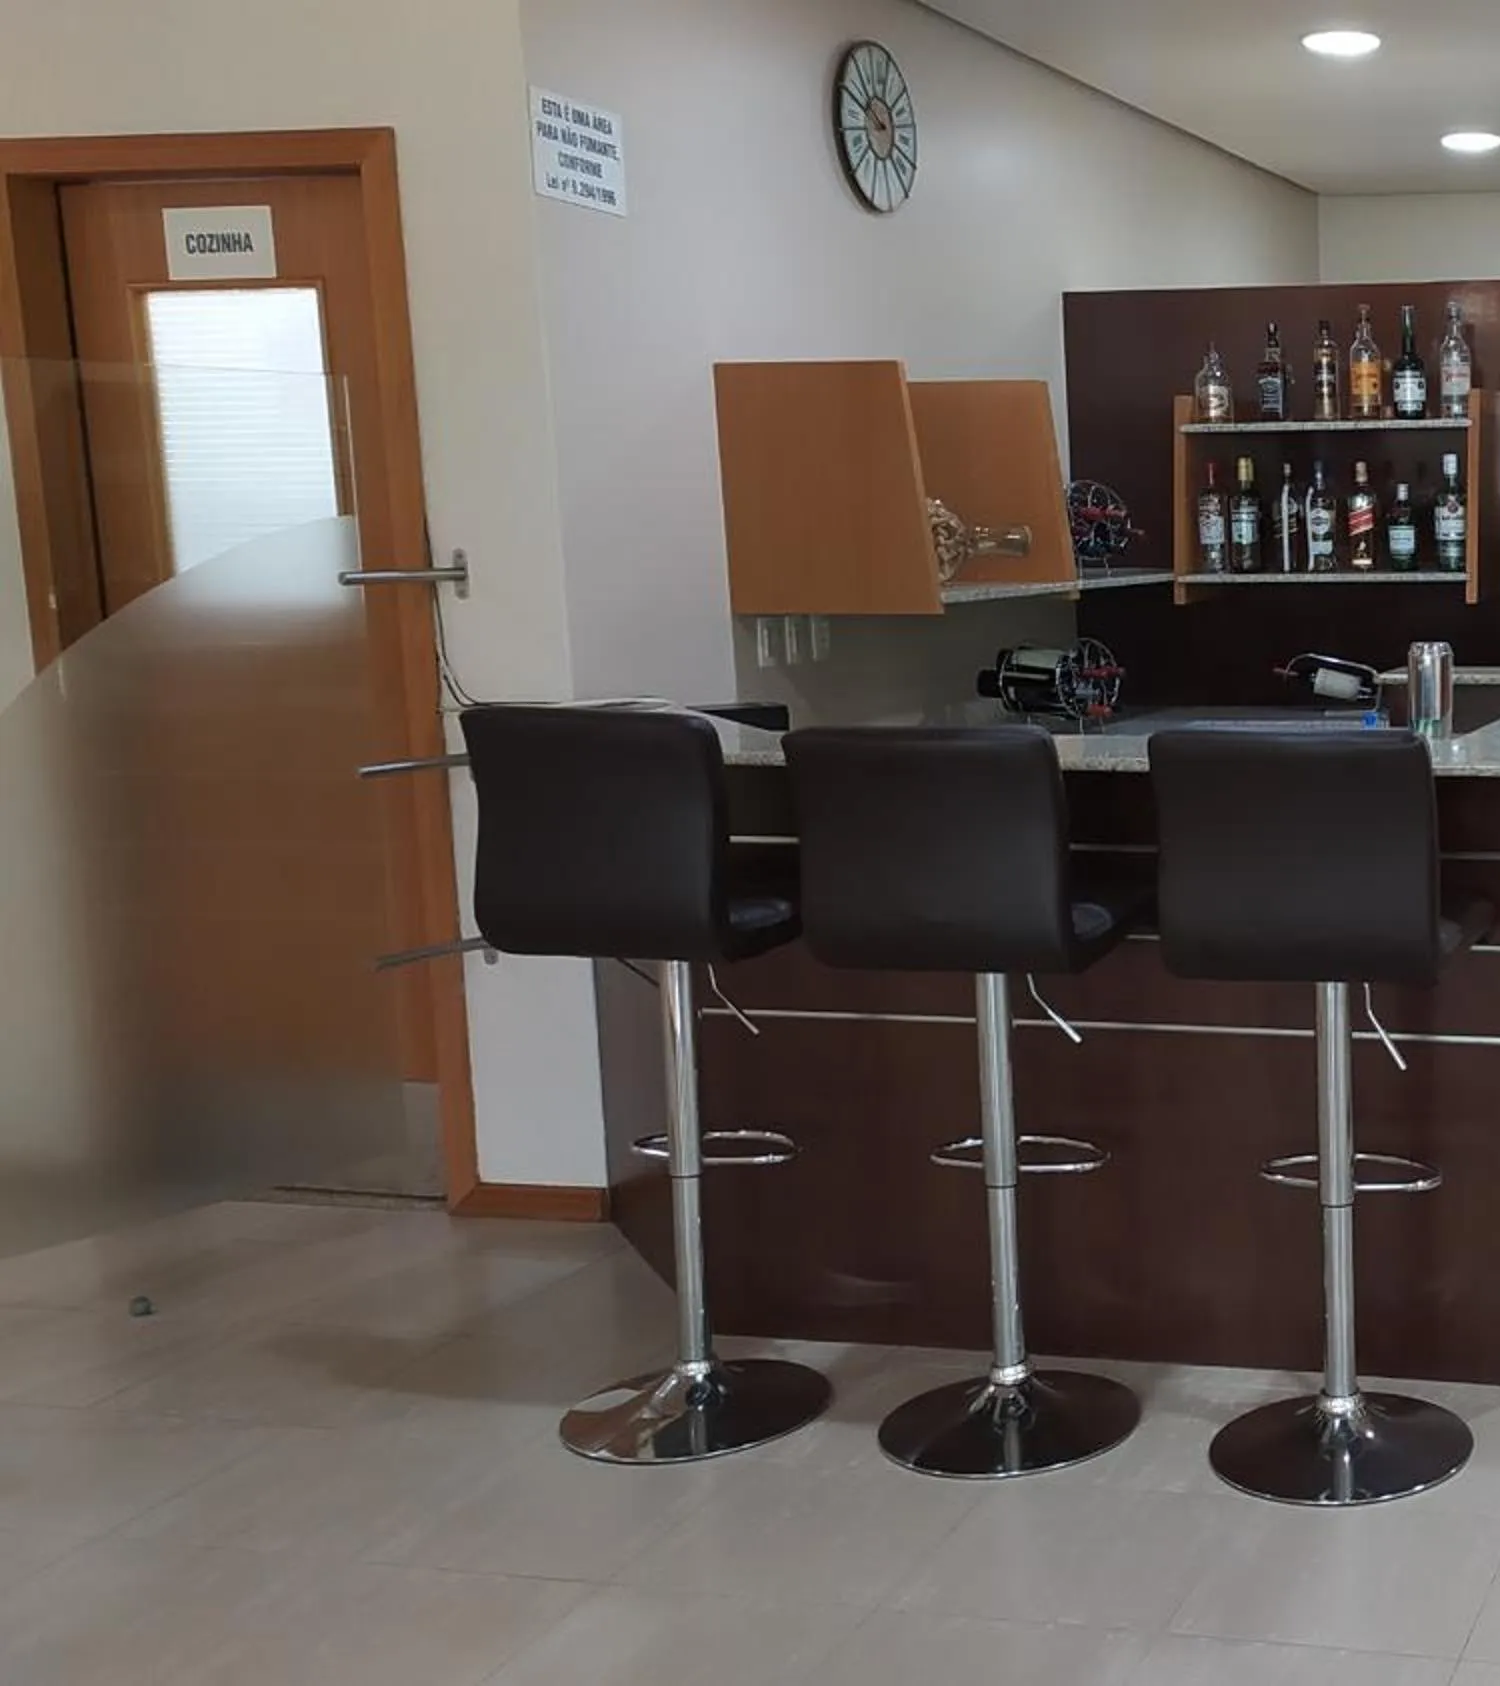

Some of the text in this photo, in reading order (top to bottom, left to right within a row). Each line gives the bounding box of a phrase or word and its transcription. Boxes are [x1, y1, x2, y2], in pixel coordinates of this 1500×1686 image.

[541, 97, 562, 119] ESTA
[571, 107, 591, 128] UMA
[536, 120, 559, 141] PARA
[561, 125, 578, 148] NÃO
[558, 151, 603, 178] CONFORME
[185, 232, 254, 254] COZINHA
